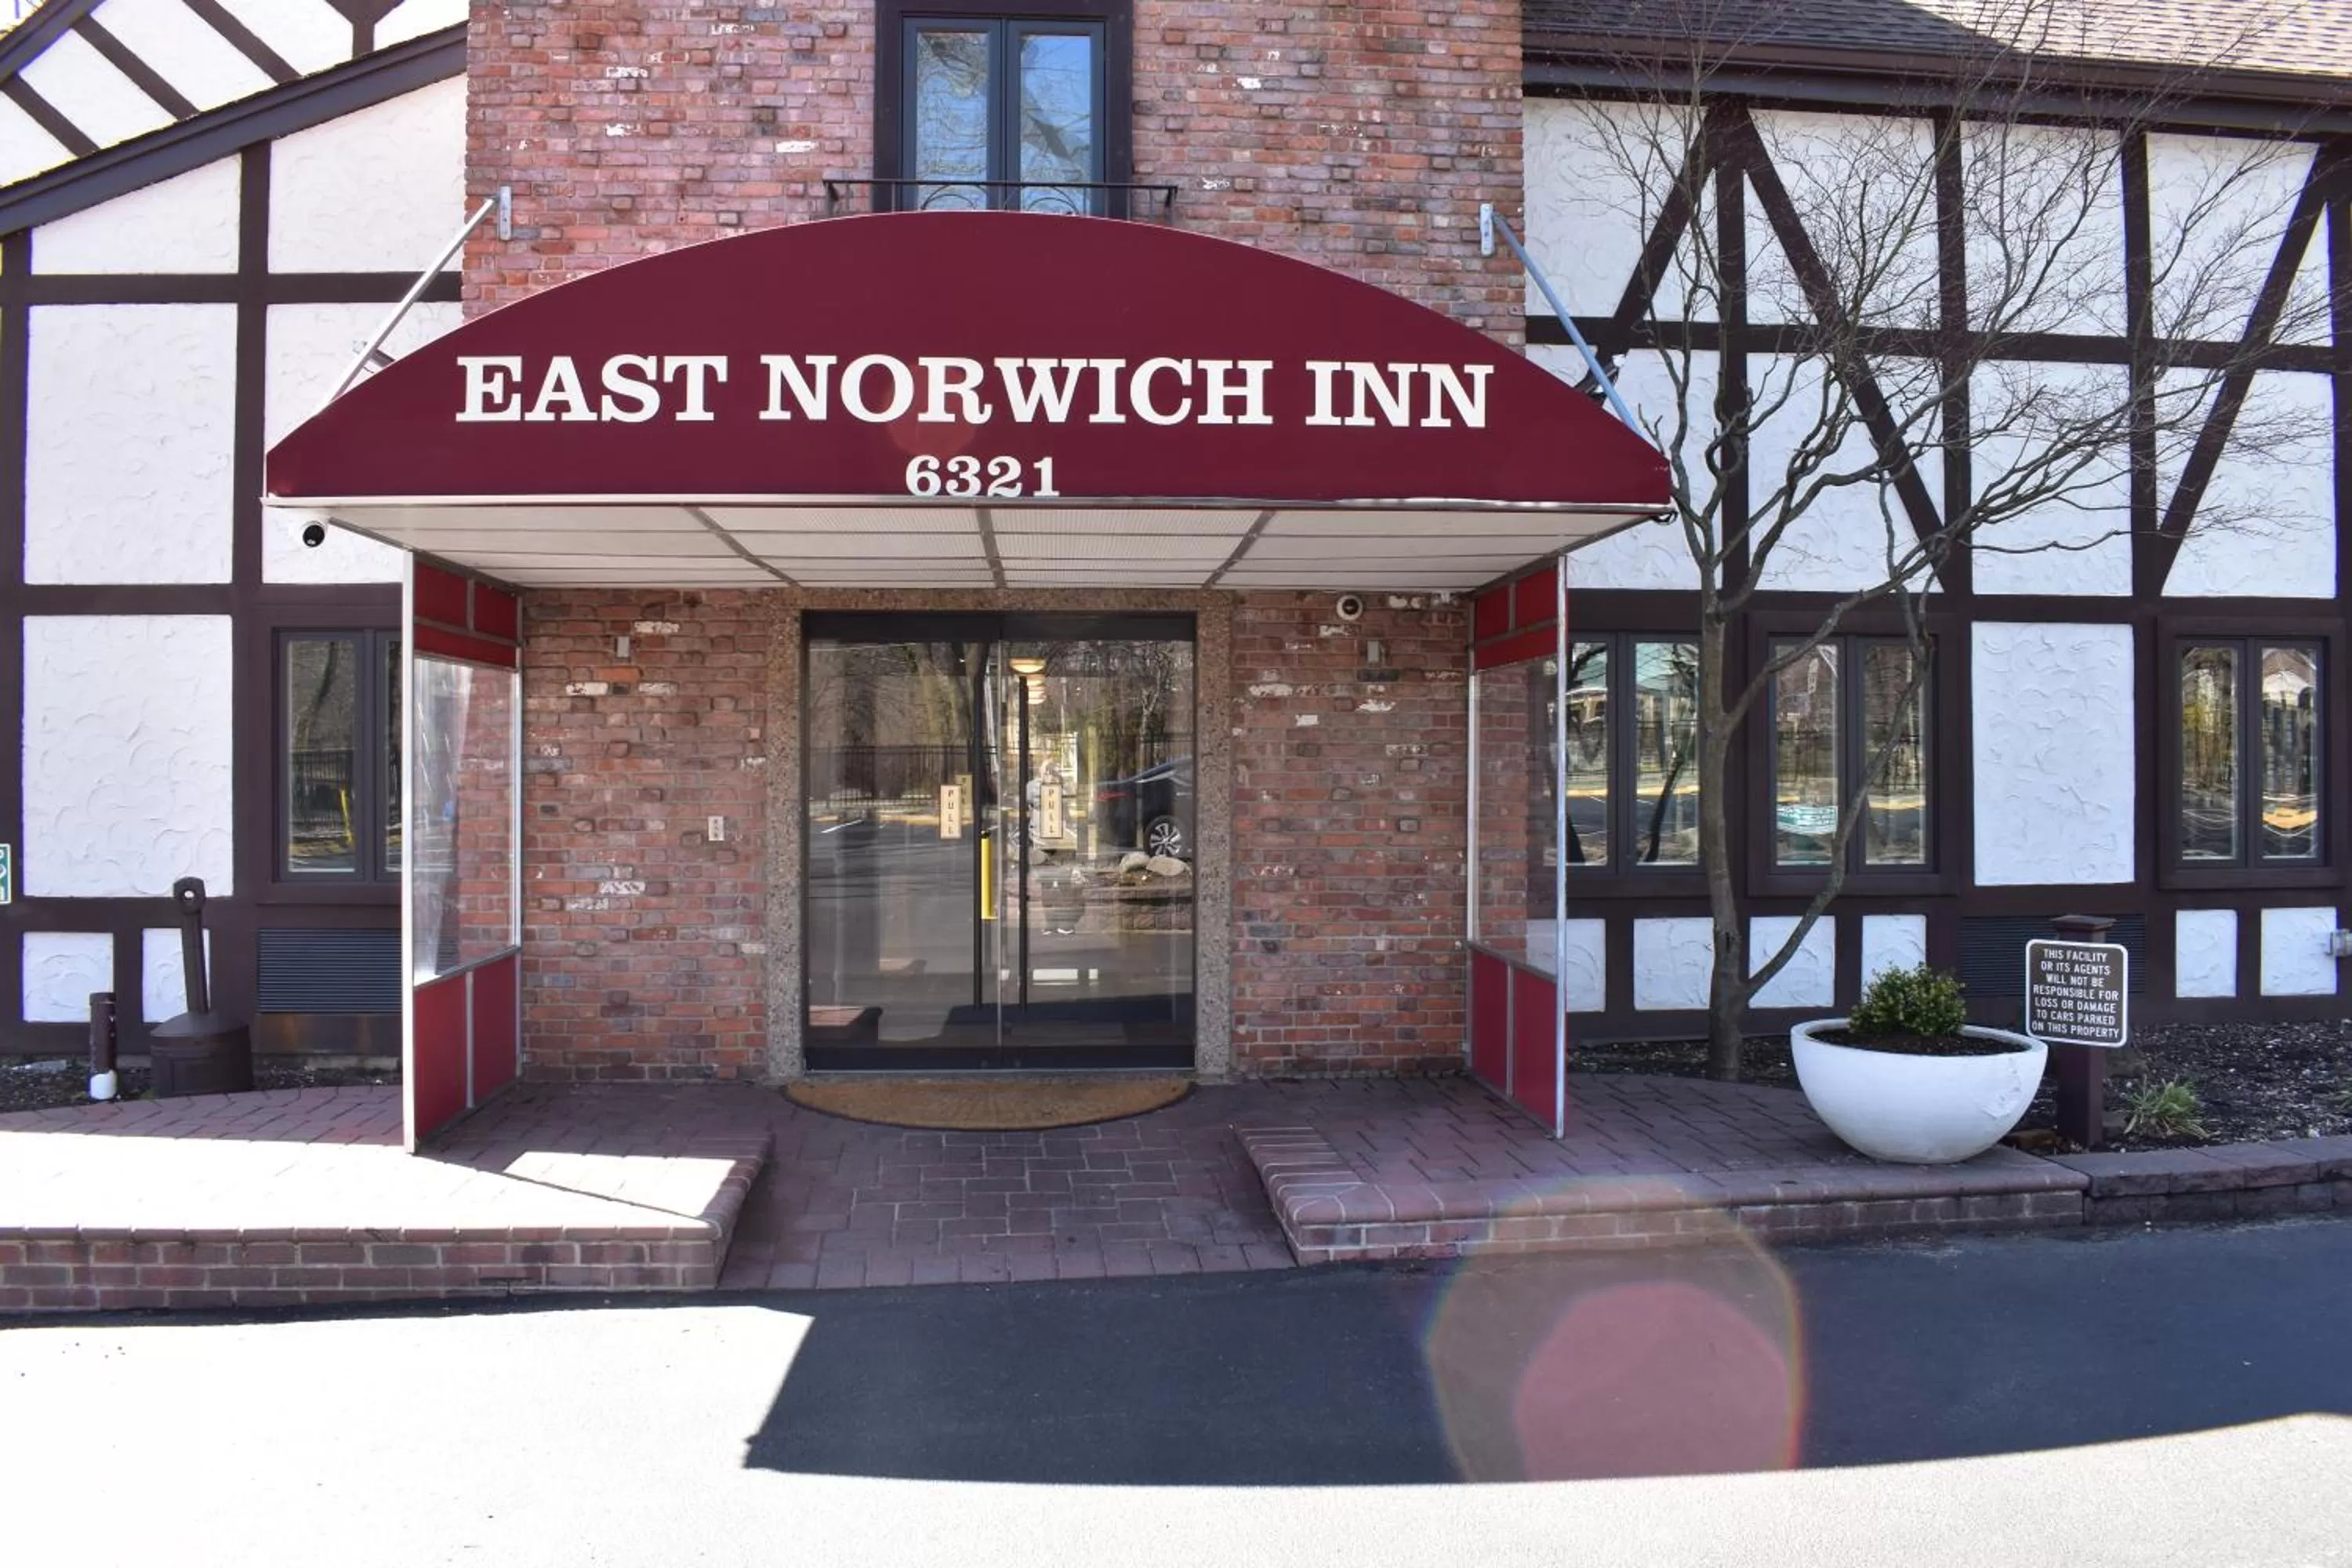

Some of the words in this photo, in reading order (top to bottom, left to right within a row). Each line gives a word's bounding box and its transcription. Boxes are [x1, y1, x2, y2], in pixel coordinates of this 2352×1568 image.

[456, 355, 728, 423] EAST
[759, 354, 1274, 426] NORWICH
[1305, 361, 1494, 429] INN
[906, 455, 1060, 498] 6321
[2043, 949, 2064, 959] THIS
[2066, 949, 2107, 963] FACILITY
[2041, 960, 2053, 971] OR
[2056, 962, 2071, 973] ITS
[2074, 964, 2111, 976] AGENTS
[2045, 973, 2067, 985] WILL
[2071, 975, 2088, 985] NOT
[2091, 977, 2105, 988] BE
[2033, 985, 2095, 1000] RESPONSIBLE
[2099, 990, 2119, 1001] FOR
[2034, 996, 2058, 1008] LOSS
[2061, 1000, 2074, 1010] OR
[2077, 1000, 2117, 1014] DAMAGE
[2037, 1009, 2048, 1019] TO
[2050, 1011, 2074, 1022] CARS
[2077, 1012, 2115, 1025] PARKED
[2031, 1021, 2044, 1032] ON
[2047, 1022, 2067, 1033] THIS
[2071, 1025, 2120, 1038] PROPERTY
